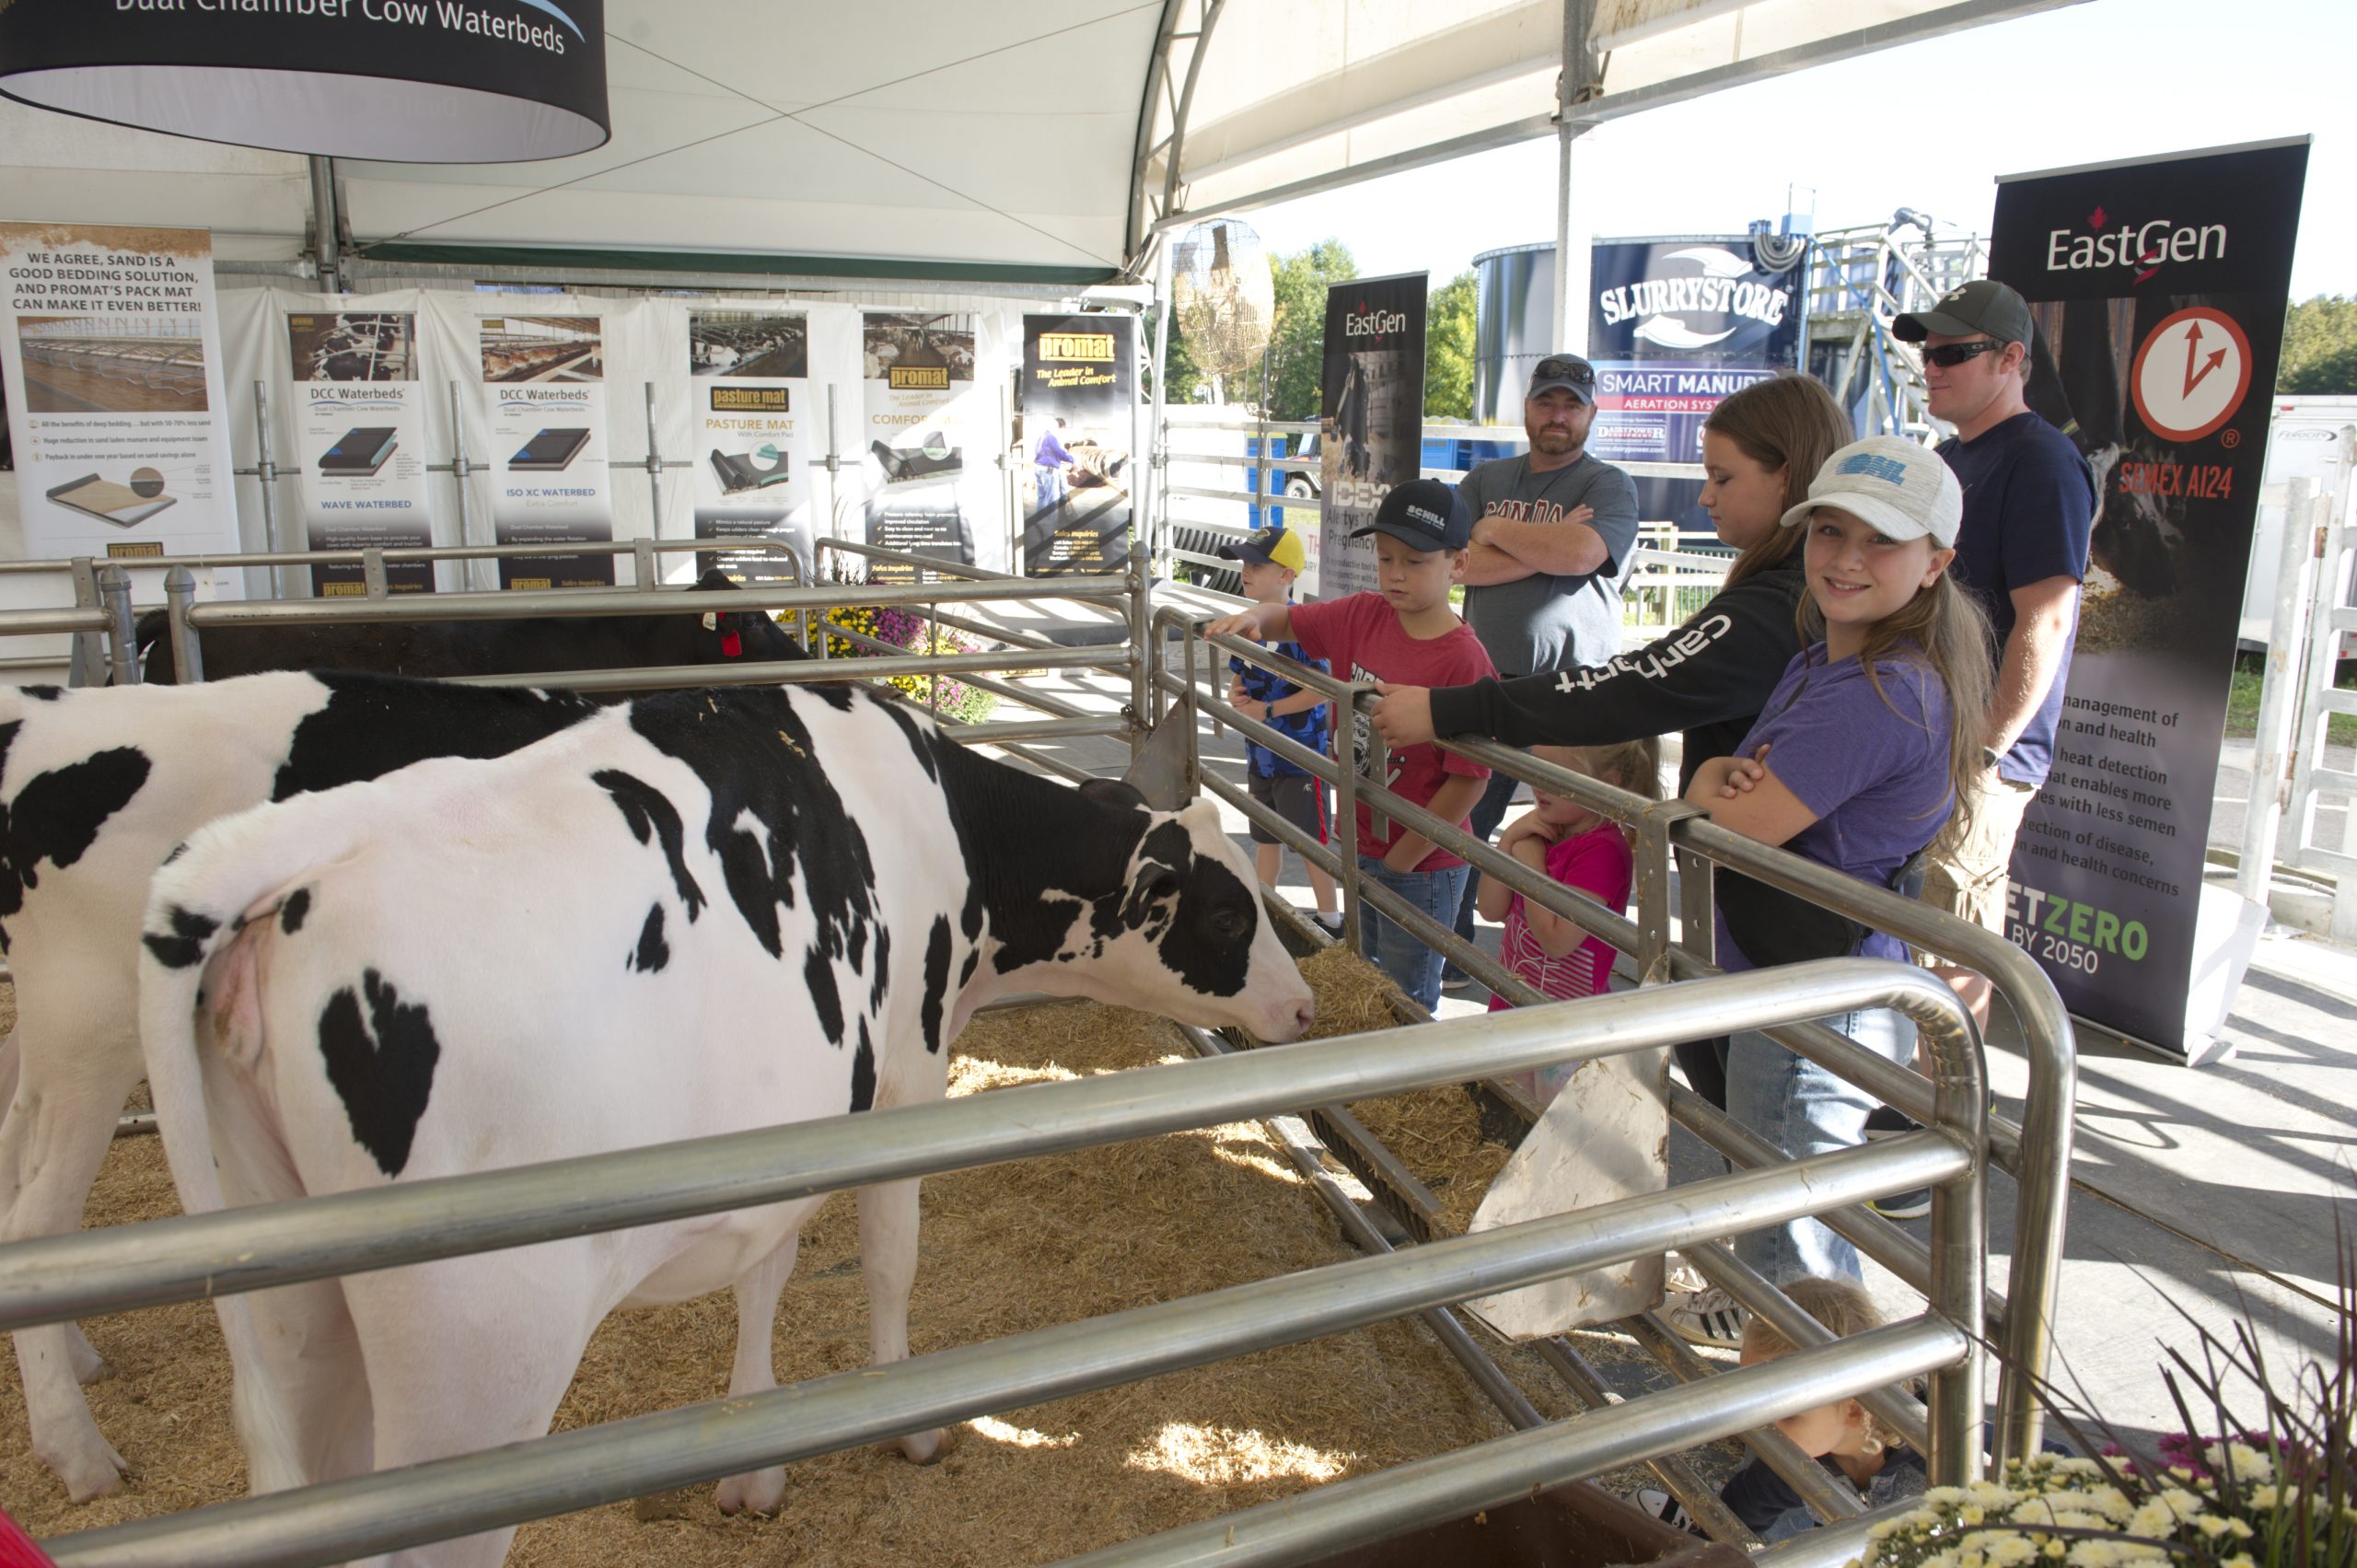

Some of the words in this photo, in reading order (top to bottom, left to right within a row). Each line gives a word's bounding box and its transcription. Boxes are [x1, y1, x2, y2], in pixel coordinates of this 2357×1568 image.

[435, 0, 566, 55] Waterbeds
[2047, 220, 2227, 271] EastGen
[28, 253, 50, 263] WE
[53, 254, 104, 266] AGREE,
[107, 255, 146, 266] SAND
[149, 256, 162, 267] IS
[166, 257, 175, 267] A
[9, 268, 53, 279] GOOD
[57, 269, 122, 281] BEDDING
[125, 271, 199, 284] SOLUTION,
[15, 284, 46, 295] AND
[51, 285, 122, 296] PROMAT'S
[126, 286, 161, 296] PACK
[165, 287, 193, 297] MAT
[12, 298, 43, 309] CAN
[47, 299, 87, 310] MAKE
[92, 300, 104, 310] IT
[108, 301, 144, 311] EVEN
[147, 301, 202, 312] BETTER!
[1346, 309, 1406, 336] EastGen
[1039, 334, 1114, 361] promat
[891, 367, 948, 388] promat
[1037, 370, 1051, 378] The
[1053, 367, 1084, 377] Leader
[1085, 366, 1094, 375] in
[1048, 377, 1078, 387] Animal
[1079, 374, 1117, 385] Comfort
[311, 389, 334, 399] DCC
[338, 388, 403, 399] Waterbeds
[1602, 374, 1675, 393] SMART
[1678, 375, 1771, 394] MANUR
[501, 389, 523, 400] DCC
[527, 389, 588, 400] Waterbeds
[714, 389, 761, 405] pasture
[762, 389, 785, 403] mat
[1624, 400, 1689, 410] AERATION
[1691, 401, 1720, 410] SYST
[706, 419, 762, 429] PASTURE
[767, 420, 794, 429] MAT
[2119, 462, 2184, 496] SEMEX
[2186, 465, 2233, 499] AI24
[506, 489, 523, 497] ISO
[542, 488, 596, 497] WATERBED
[321, 501, 352, 509] WAVE
[354, 500, 412, 508] WATERBED
[1407, 505, 1445, 526] SCHILL
[323, 583, 366, 597] promat
[2161, 713, 2179, 727] of
[2074, 721, 2105, 737] and
[2109, 725, 2156, 748] health
[2060, 748, 2094, 767] heat
[2097, 756, 2167, 784] detection
[2071, 776, 2129, 799] enables
[2132, 790, 2173, 810] more
[2059, 796, 2092, 814] with
[2096, 803, 2124, 822] less
[2127, 814, 2177, 837] semen
[2023, 819, 2071, 842] tection
[2075, 832, 2094, 846] of
[2096, 836, 2154, 866] disease,
[2031, 842, 2058, 860] and
[2061, 850, 2108, 875] health
[2112, 866, 2180, 897] concerns
[2005, 880, 2148, 961] ETZERO
[2011, 923, 2038, 951] BY
[2042, 935, 2099, 974] 2050
